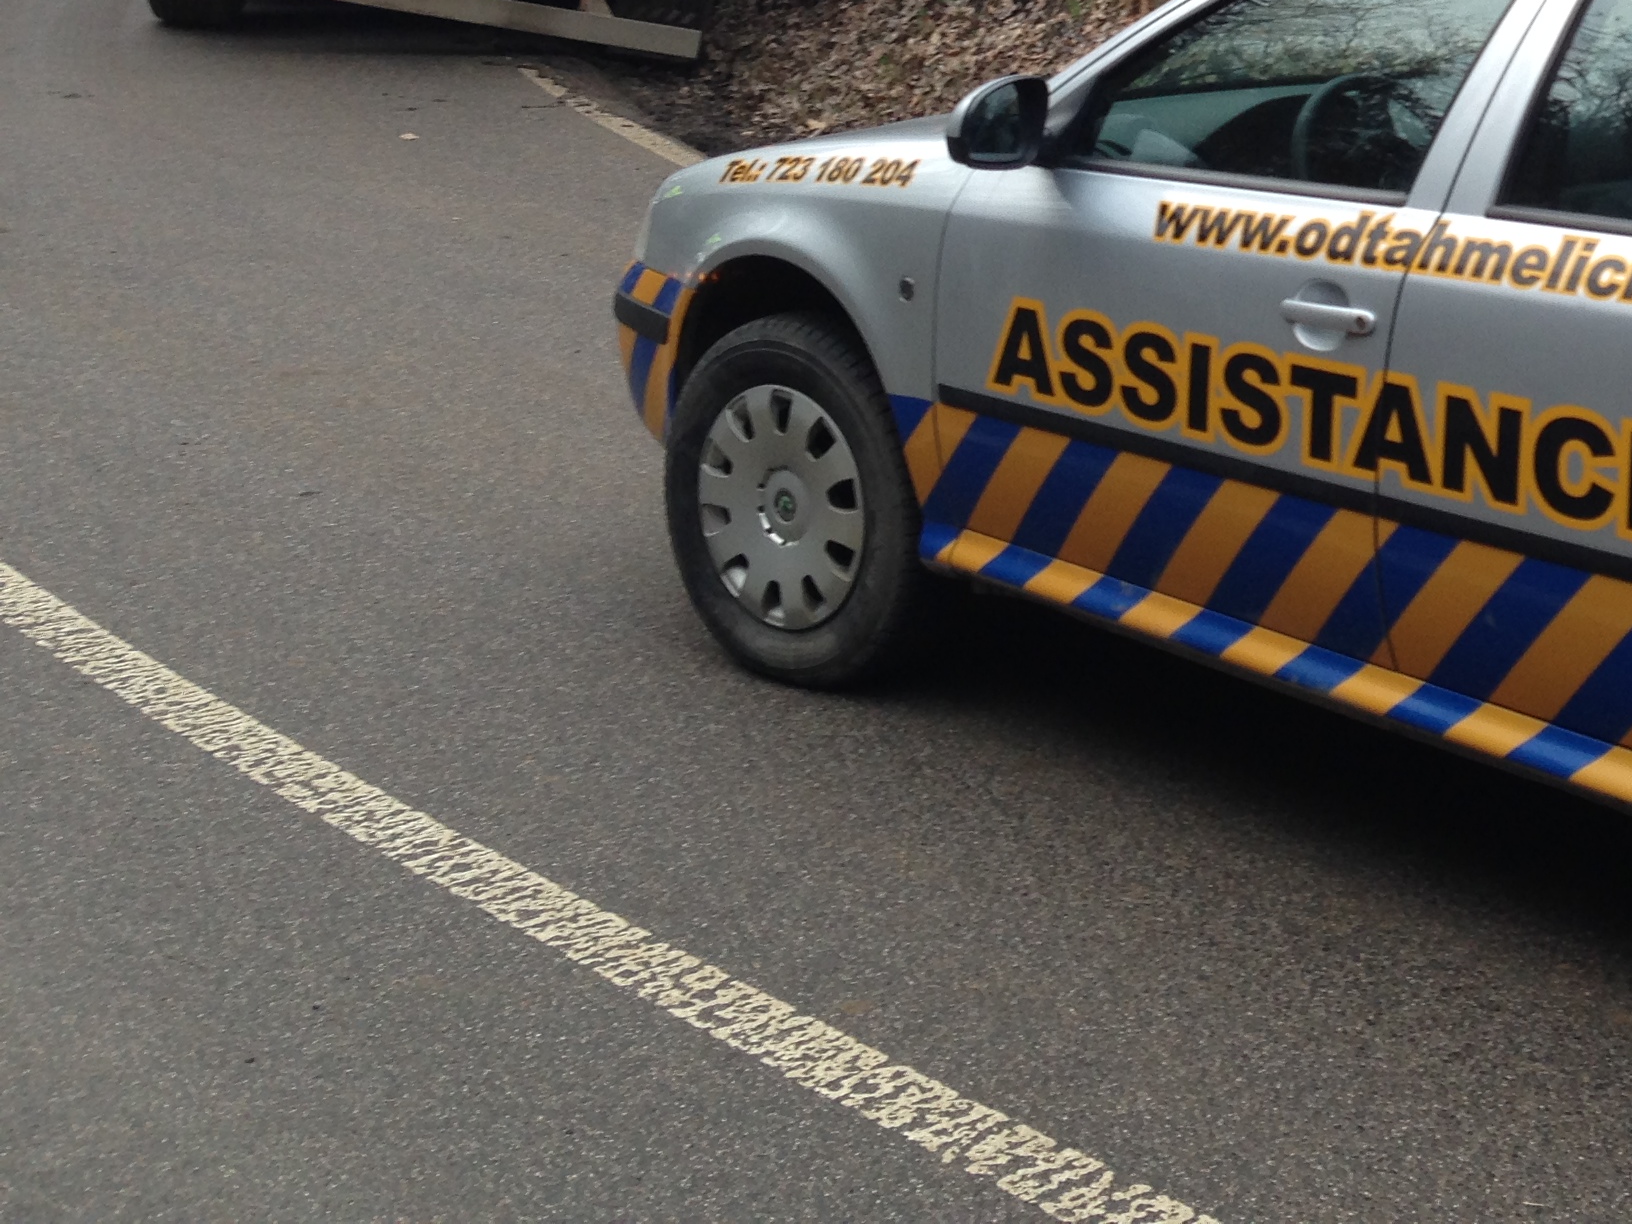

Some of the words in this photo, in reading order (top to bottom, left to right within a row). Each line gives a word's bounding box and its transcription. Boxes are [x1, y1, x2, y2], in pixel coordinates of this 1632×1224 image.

[765, 155, 816, 183] 723
[814, 156, 866, 184] 180
[859, 158, 922, 188] 204
